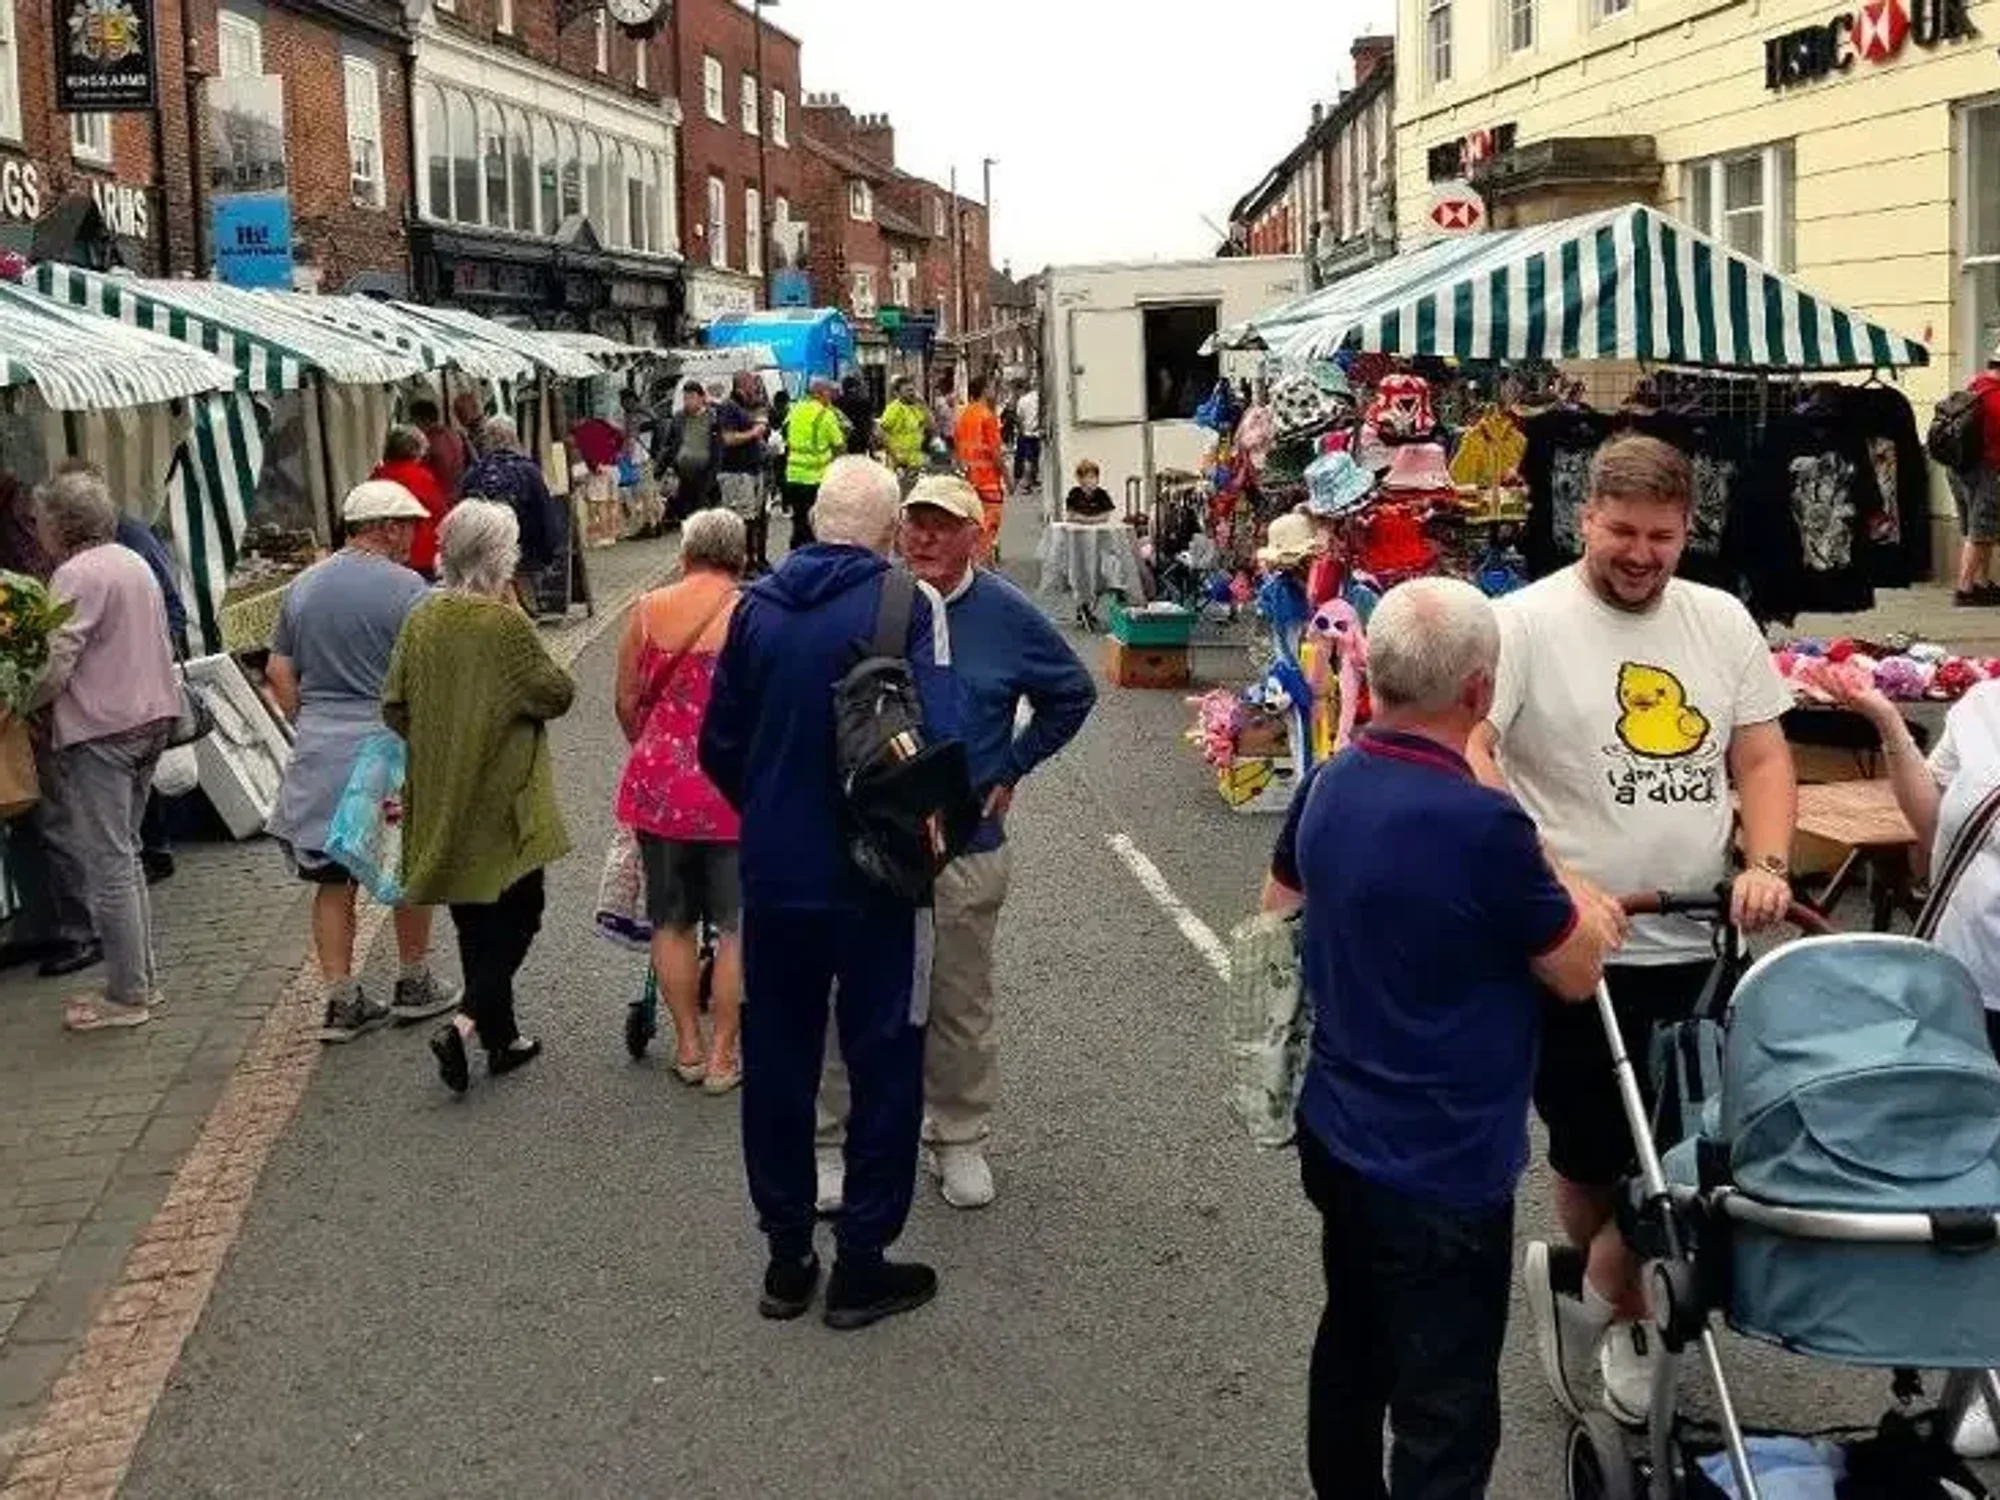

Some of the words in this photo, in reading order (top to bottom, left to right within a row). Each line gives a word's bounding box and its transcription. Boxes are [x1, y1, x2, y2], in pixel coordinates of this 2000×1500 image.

[1910, 0, 1981, 48] UK
[109, 73, 147, 87] ARMS
[0, 160, 40, 219] GS
[1615, 785, 1635, 804] a
